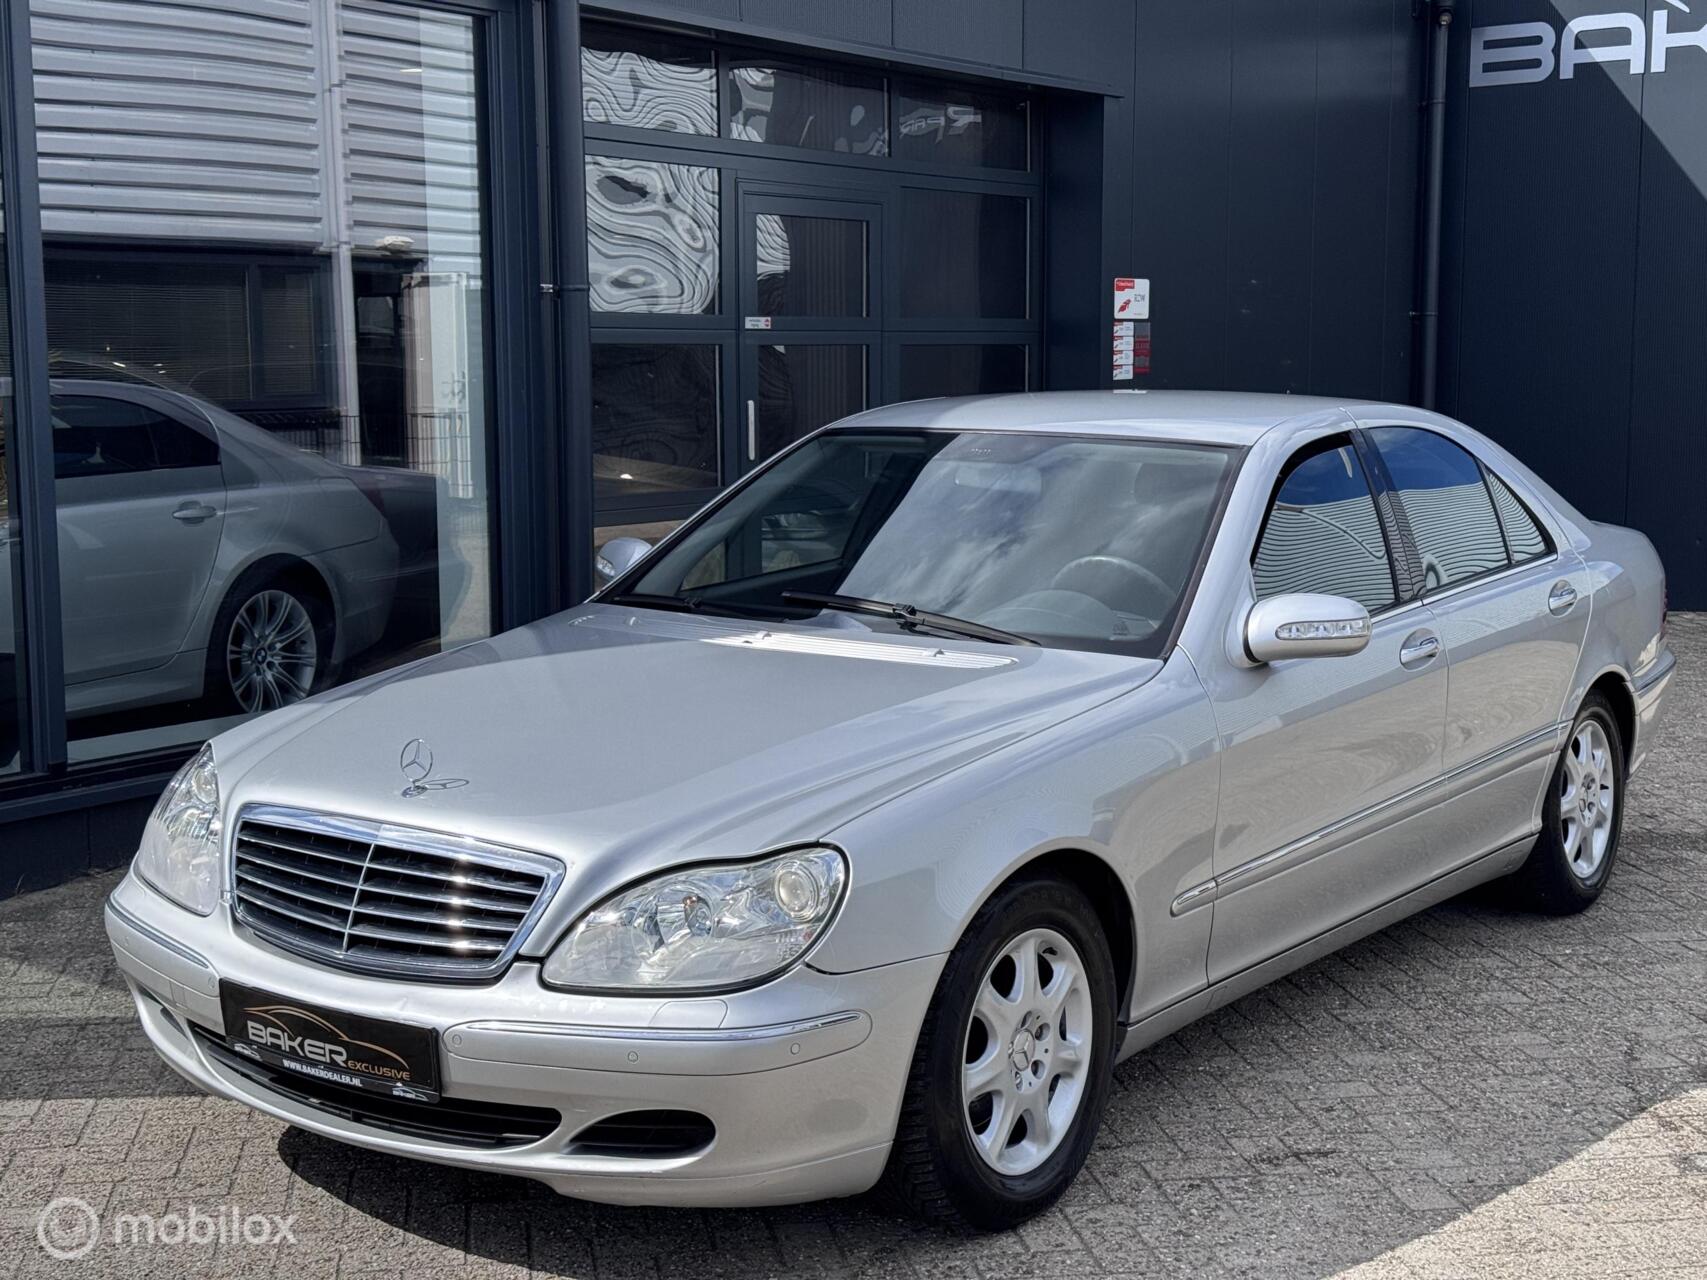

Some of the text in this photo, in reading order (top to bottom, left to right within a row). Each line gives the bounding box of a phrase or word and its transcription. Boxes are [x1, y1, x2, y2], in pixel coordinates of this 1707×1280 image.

[246, 1019, 349, 1068] BAKER
[282, 1058, 363, 1087] WWW.BAKERDEALER.NL
[347, 1060, 411, 1081] EXCLUSIVE
